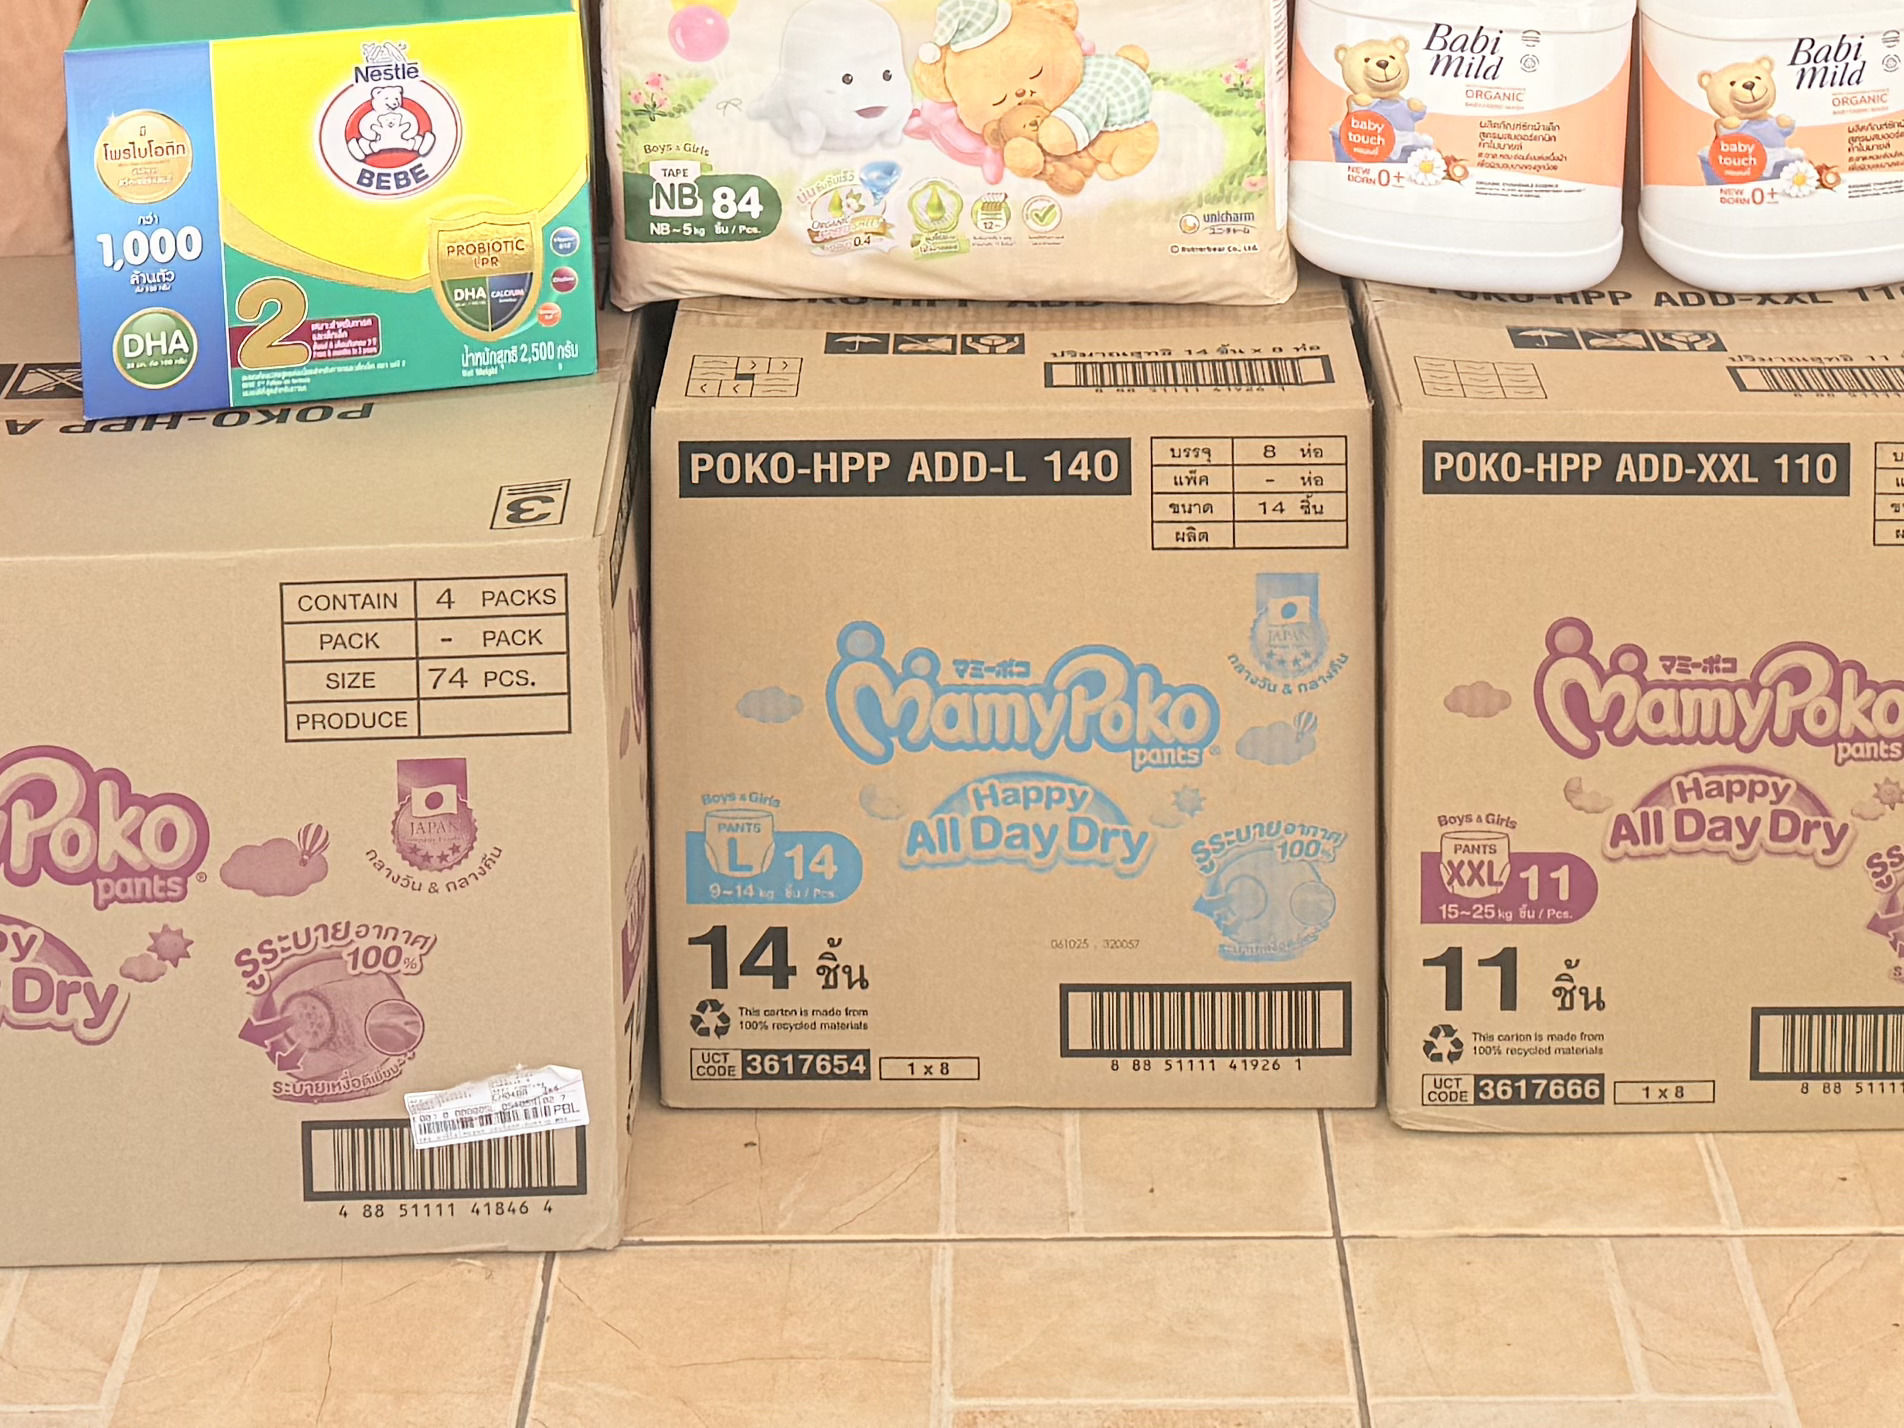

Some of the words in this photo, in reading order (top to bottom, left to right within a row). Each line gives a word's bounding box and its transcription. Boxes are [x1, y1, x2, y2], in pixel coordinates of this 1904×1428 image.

[1422, 22, 1505, 56] Babi
[1787, 33, 1865, 67] Babi
[1464, 88, 1525, 102] ORGANIC
[1348, 131, 1386, 146] touch
[1350, 117, 1385, 135] baby
[654, 181, 700, 214] NB
[711, 185, 764, 218] 84
[1202, 209, 1255, 226] unicharm
[690, 450, 891, 485] POKO-HPP
[905, 449, 1027, 484] ADD-L
[1043, 447, 1121, 483] 140
[1169, 443, 1214, 466] บรรจุ
[1262, 445, 1276, 460] 8
[1299, 441, 1325, 461] ห่อ
[1433, 451, 1603, 484] POKO-HPP
[1615, 451, 1759, 485] ADD-XXL
[1773, 452, 1838, 485] 110
[1257, 500, 1287, 516] 14
[297, 589, 399, 615] CONTAIN
[434, 587, 457, 611] 4
[480, 583, 559, 609] PACKS
[318, 628, 383, 653] PACK
[482, 623, 543, 649] PACK
[322, 667, 377, 691] SIZE
[826, 621, 1221, 766] MamyPoko
[294, 706, 407, 732] PRODUCE
[1676, 774, 1792, 807] Happy
[970, 816, 1063, 861] Day
[1067, 816, 1149, 863] Dry
[1673, 811, 1762, 852] Day
[1768, 810, 1849, 856] Dry
[728, 838, 753, 873] L
[96, 874, 186, 907] pants
[1446, 860, 1505, 890] XXL
[346, 945, 419, 974] 100%
[687, 924, 798, 990] 14
[815, 936, 870, 992] ชิ้น
[1421, 946, 1519, 1012] 11
[1551, 957, 1606, 1014] ชิ้น
[695, 1064, 738, 1078] CODE
[744, 1053, 869, 1077] 3617654
[1478, 1078, 1601, 1102] 3617666
[361, 1203, 387, 1218] 88
[399, 1201, 458, 1219] 51111
[470, 1200, 531, 1218] 41846
